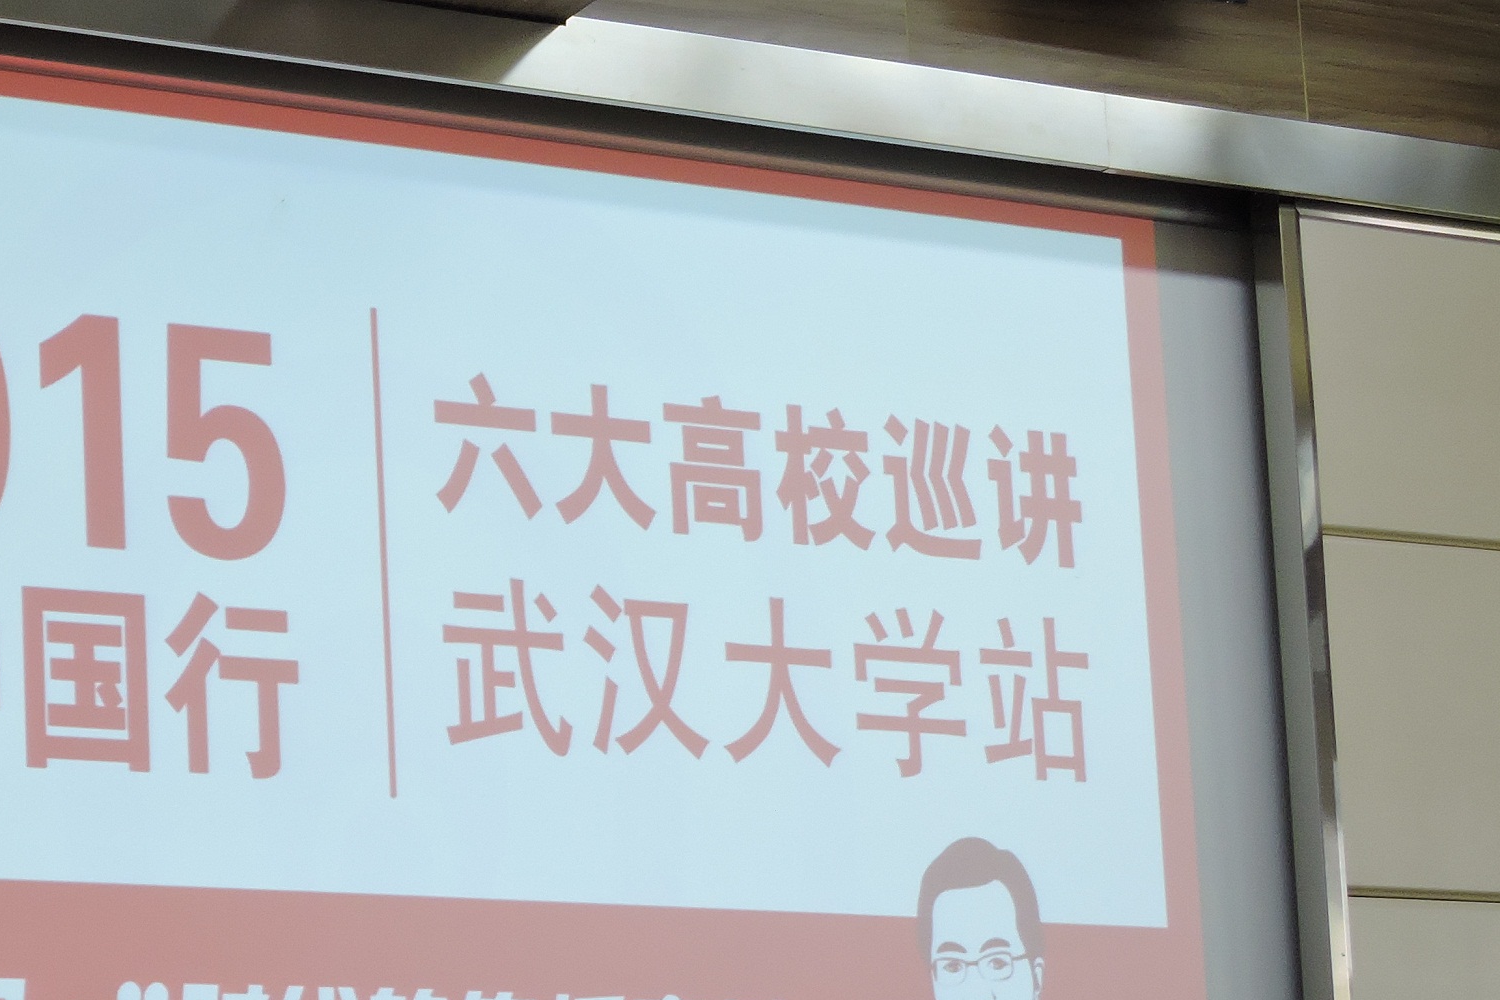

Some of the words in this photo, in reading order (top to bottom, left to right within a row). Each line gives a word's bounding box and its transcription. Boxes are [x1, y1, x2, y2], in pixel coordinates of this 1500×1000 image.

[433, 372, 1083, 568] 六大高校巡讲
[441, 577, 1089, 783] 武汉大学站
